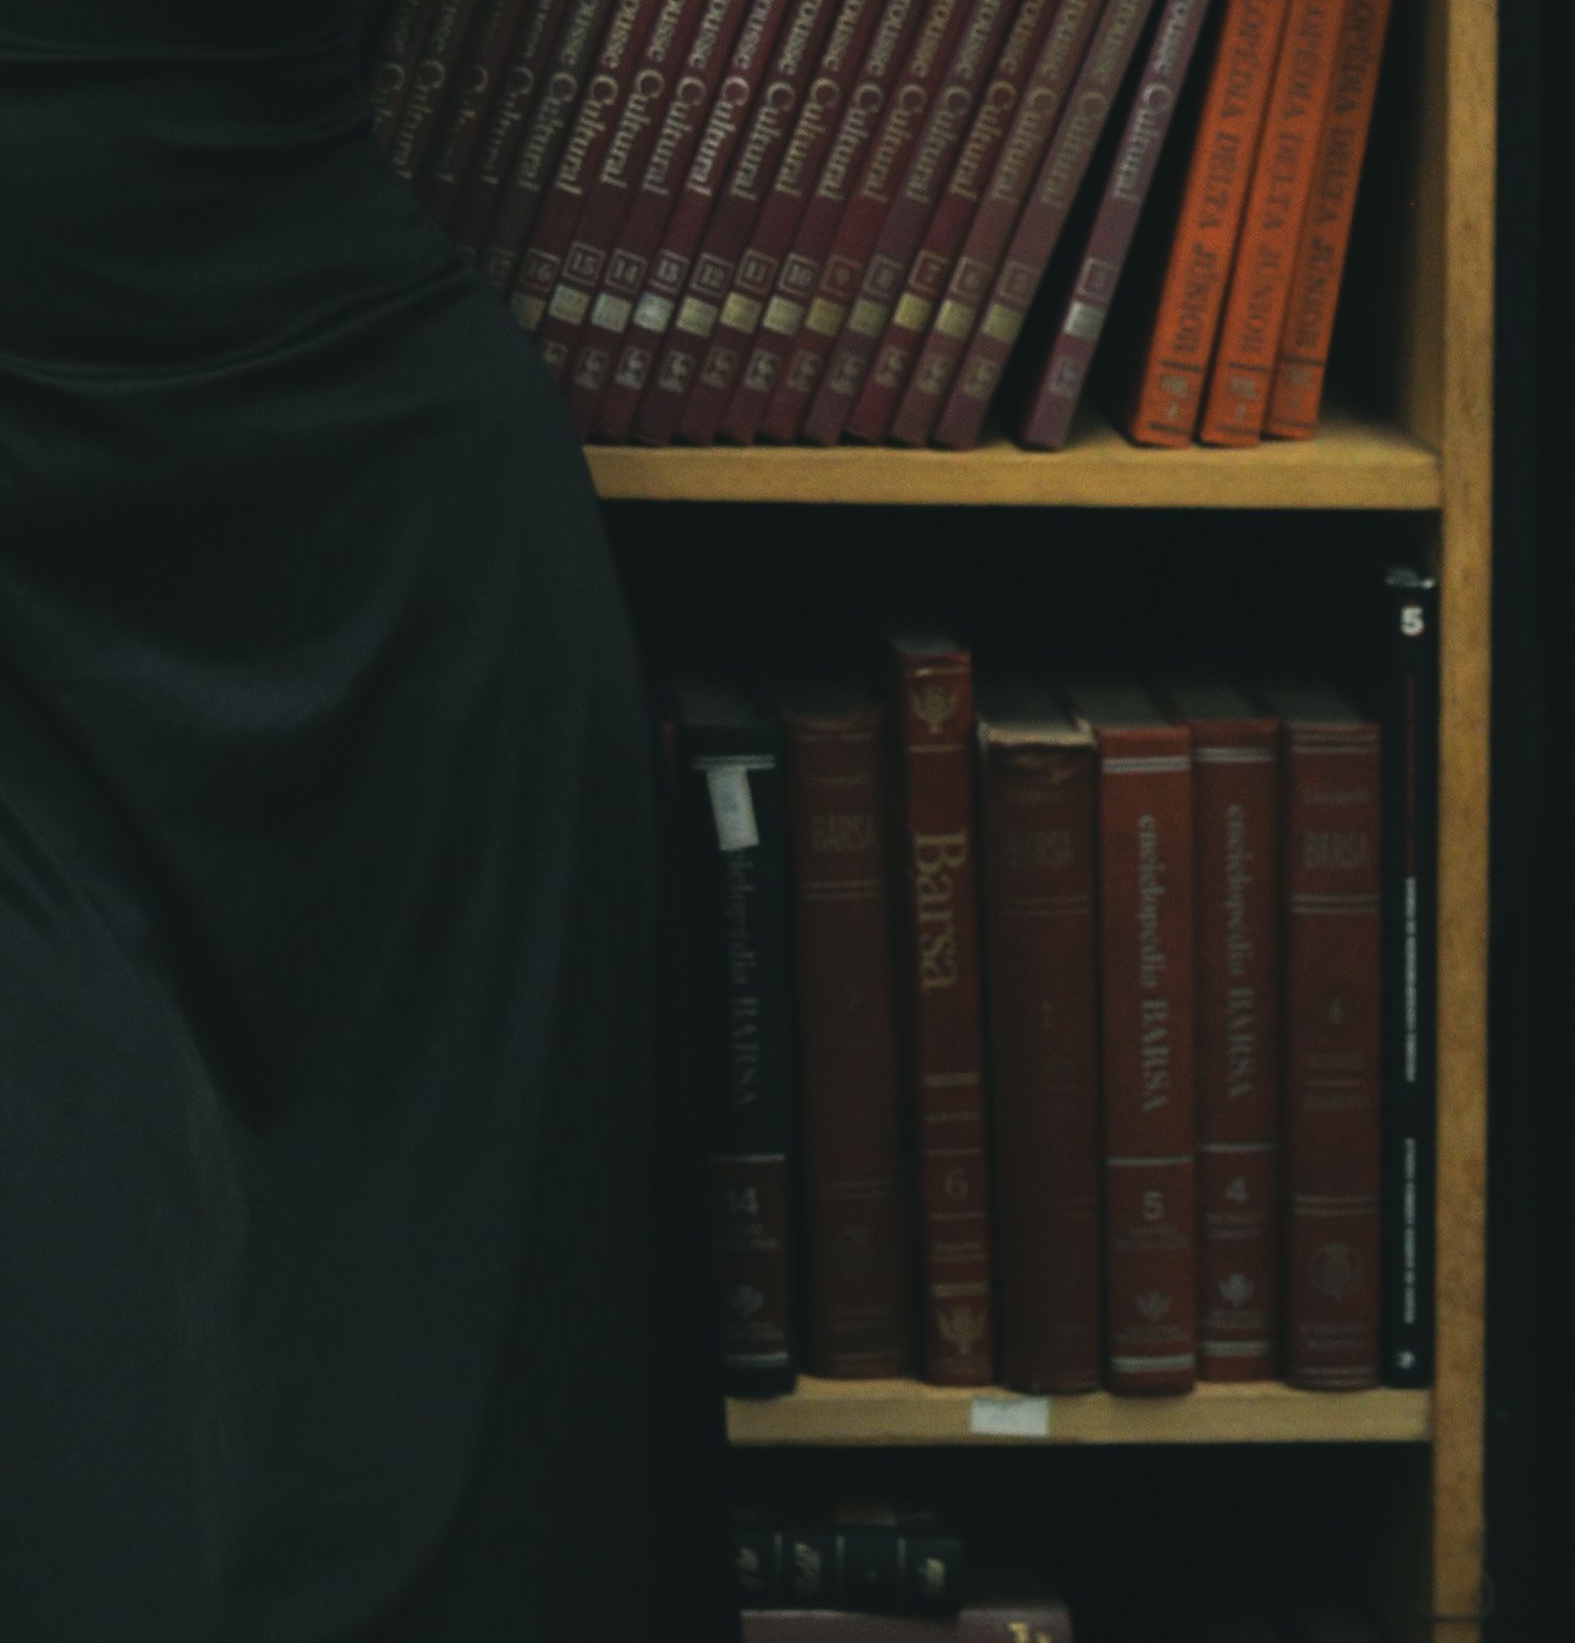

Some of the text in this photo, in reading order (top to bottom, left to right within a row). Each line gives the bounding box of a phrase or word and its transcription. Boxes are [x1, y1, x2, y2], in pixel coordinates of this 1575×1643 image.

[554, 73, 620, 197] Cultural
[598, 67, 665, 189] Cultural
[1401, 607, 1424, 635] 5
[913, 828, 968, 993] Barsa
[1140, 999, 1169, 1113] BARSA
[1227, 986, 1255, 1098] BARSA
[945, 1168, 968, 1199] 6
[1141, 1189, 1165, 1221] 5
[1226, 1176, 1249, 1203] 4
